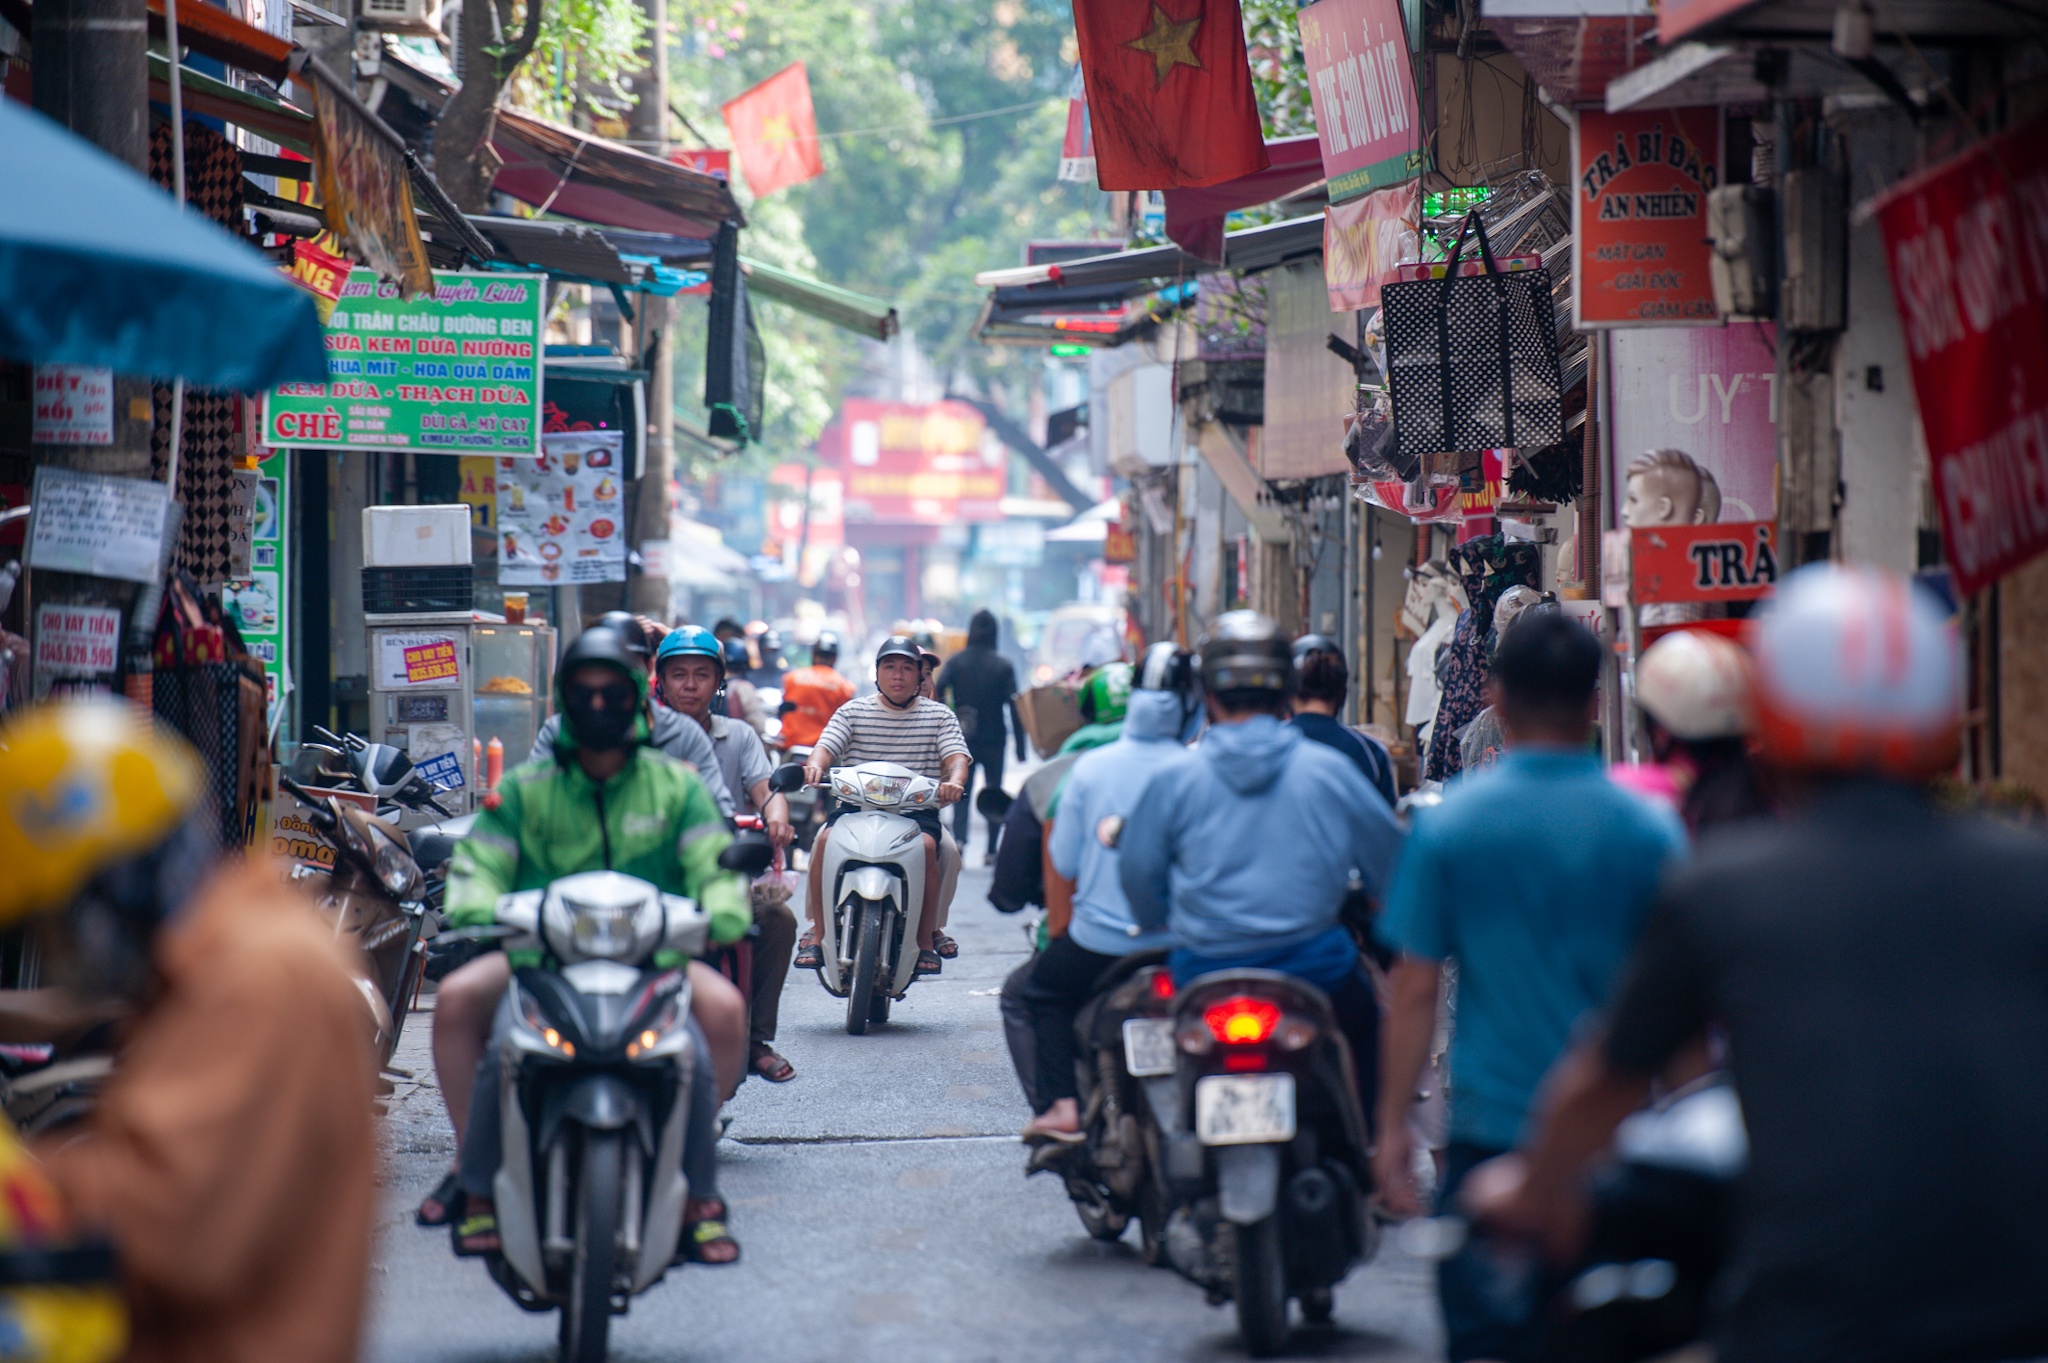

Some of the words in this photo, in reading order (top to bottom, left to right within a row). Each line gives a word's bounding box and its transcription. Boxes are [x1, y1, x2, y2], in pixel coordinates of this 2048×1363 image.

[1581, 131, 1632, 199] TRÀ
[1600, 194, 1630, 219] AN
[1634, 184, 1697, 219] NHIÊN
[283, 263, 337, 293] NG
[353, 310, 395, 331] TRÂN
[398, 312, 441, 333] CHÂU
[500, 317, 534, 337] ĐEN
[367, 336, 412, 354] KEM
[366, 357, 399, 376] MÍT
[414, 362, 449, 379] HOA
[453, 359, 488, 380] QUẢ
[330, 379, 381, 400] DỪA
[397, 385, 475, 406] THẠCH
[479, 385, 531, 406] DỪA
[1669, 373, 1744, 425] UY
[275, 406, 342, 440] CHÈ
[500, 416, 530, 433] CAY
[1689, 528, 1777, 588] TRÀ
[64, 613, 85, 633] VAY
